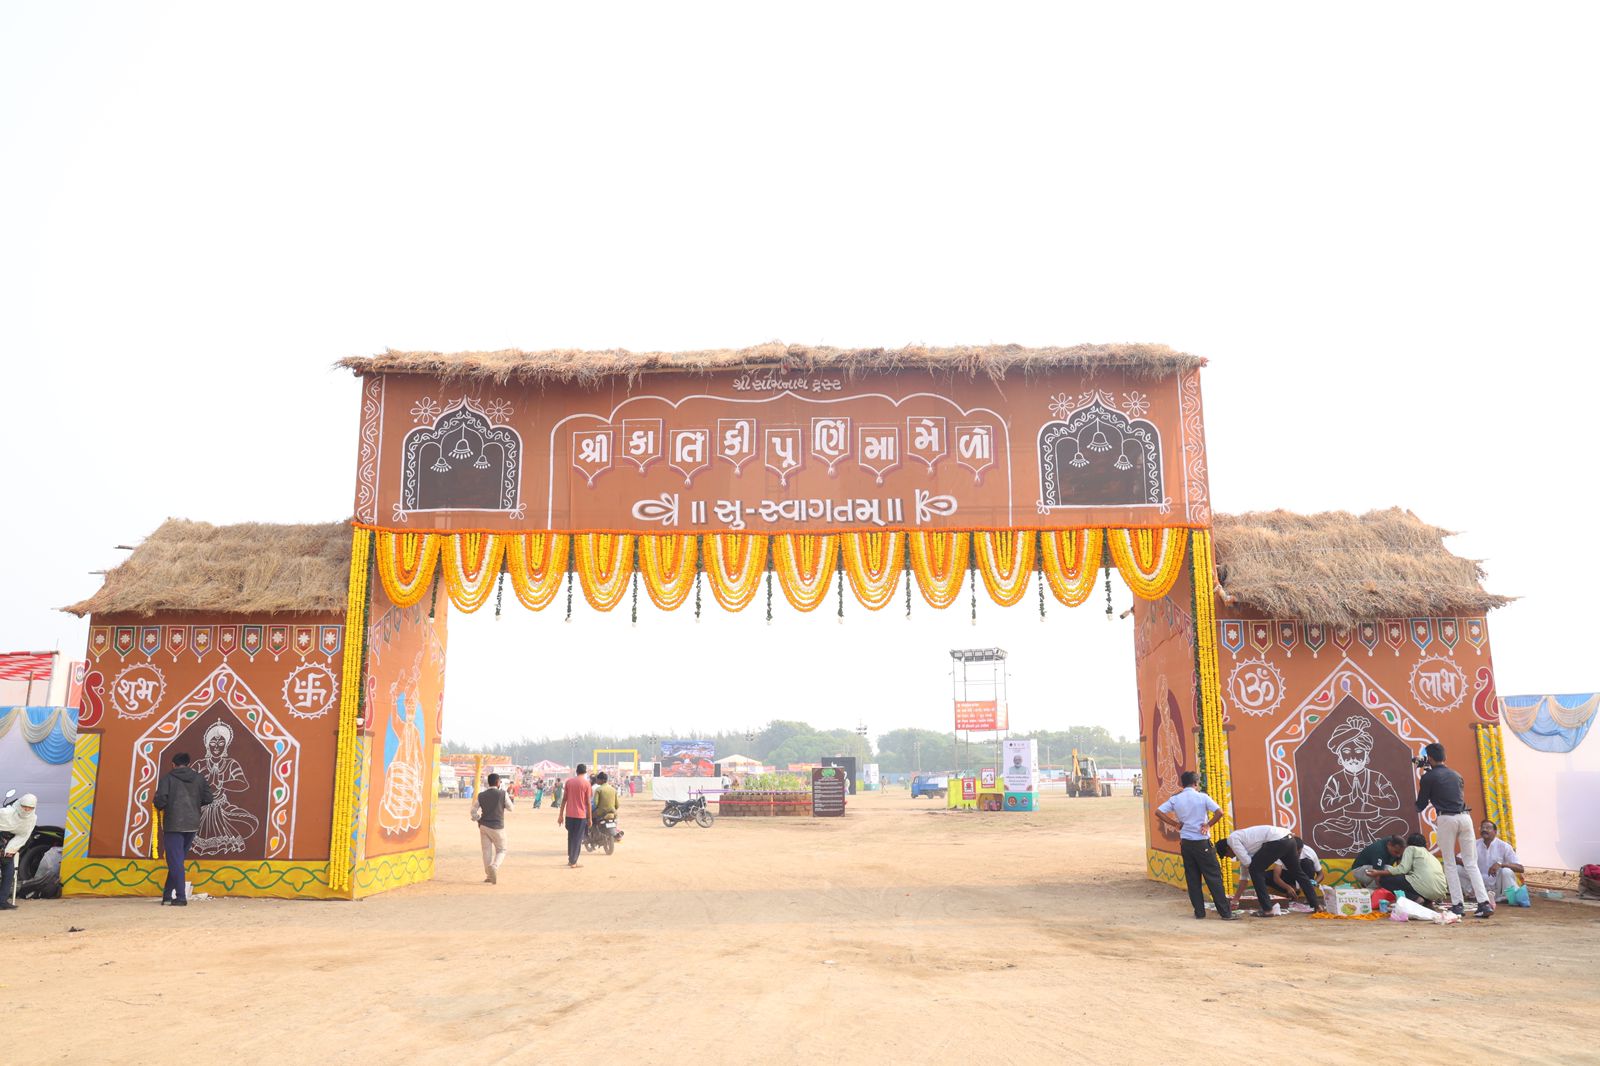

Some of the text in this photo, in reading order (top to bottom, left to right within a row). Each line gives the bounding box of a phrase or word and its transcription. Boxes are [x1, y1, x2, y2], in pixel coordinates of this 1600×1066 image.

[733, 375, 751, 391] શ્રી
[578, 434, 608, 463] શ્રી
[117, 677, 159, 711] शुभ
[1418, 667, 1458, 703] लाभ
